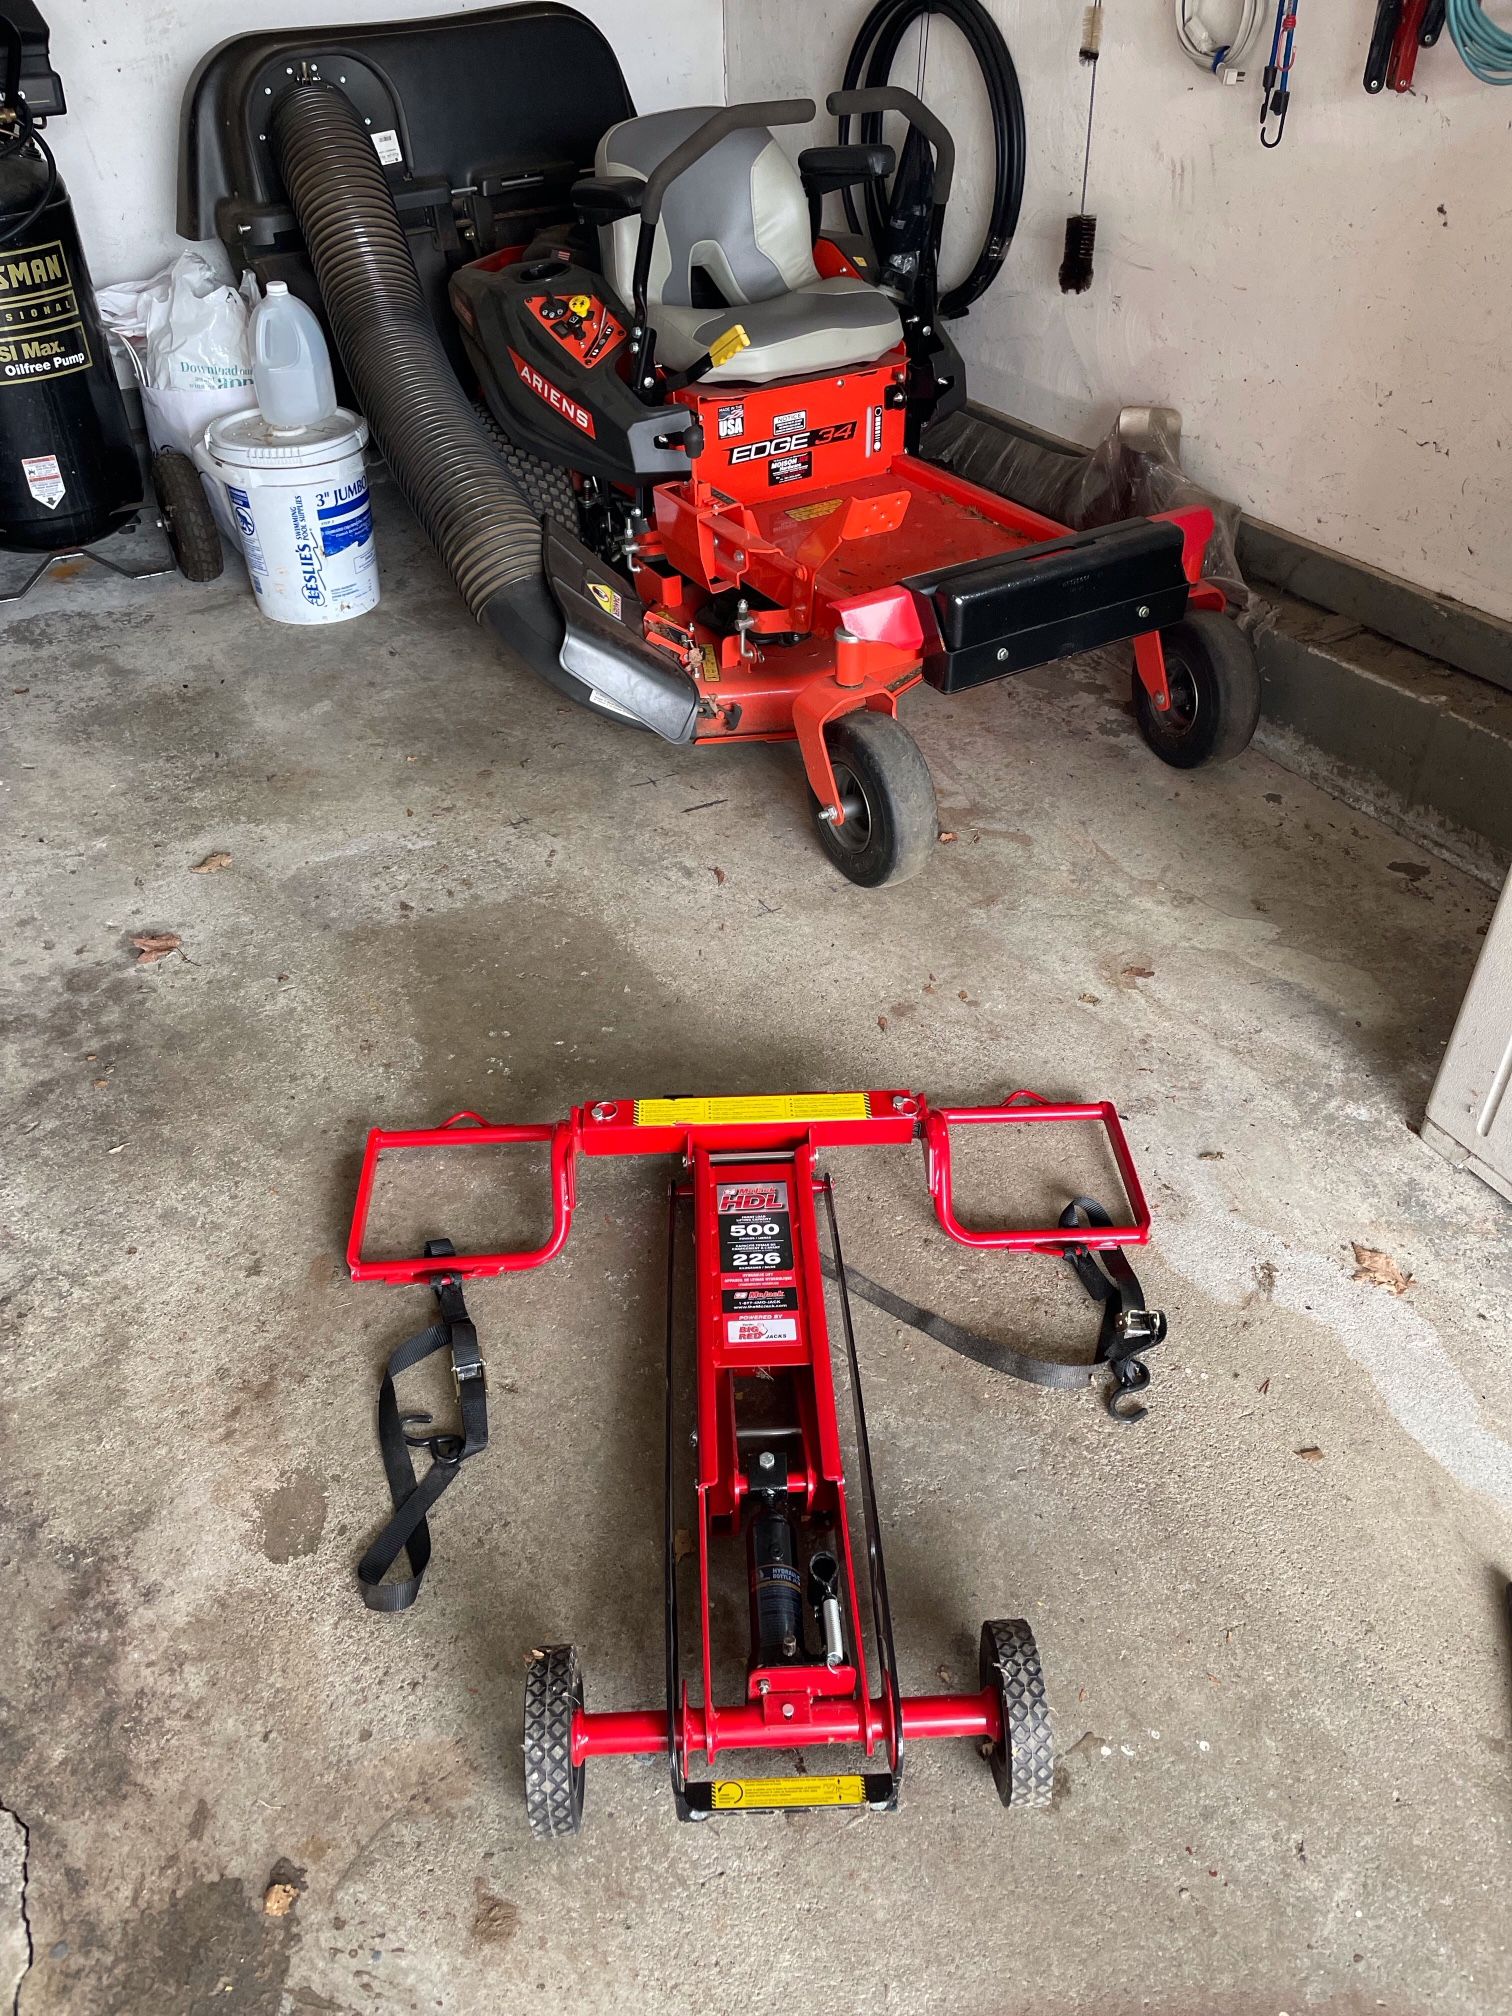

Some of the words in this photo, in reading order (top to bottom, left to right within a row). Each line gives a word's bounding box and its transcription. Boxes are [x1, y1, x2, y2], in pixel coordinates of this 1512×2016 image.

[21, 340, 65, 360] Max.
[5, 361, 51, 376] Oilfree
[53, 352, 85, 368] Pump
[521, 366, 588, 428] ARIENS
[718, 417, 743, 437] USA
[777, 412, 802, 422] NOTICE
[732, 432, 811, 464] EDGE
[814, 424, 853, 445] 34
[771, 458, 798, 469] MOISON
[333, 475, 367, 507] JUMBO
[294, 495, 306, 523] SUPPLIES
[290, 506, 302, 540] SWIMMING
[300, 524, 309, 540] POOL
[295, 543, 322, 604] LESLIE'S
[719, 1193, 783, 1211] HDL
[730, 1223, 780, 1237] 500
[732, 1252, 781, 1266] 226
[738, 1325, 760, 1333] BIG
[738, 1332, 764, 1340] RED
